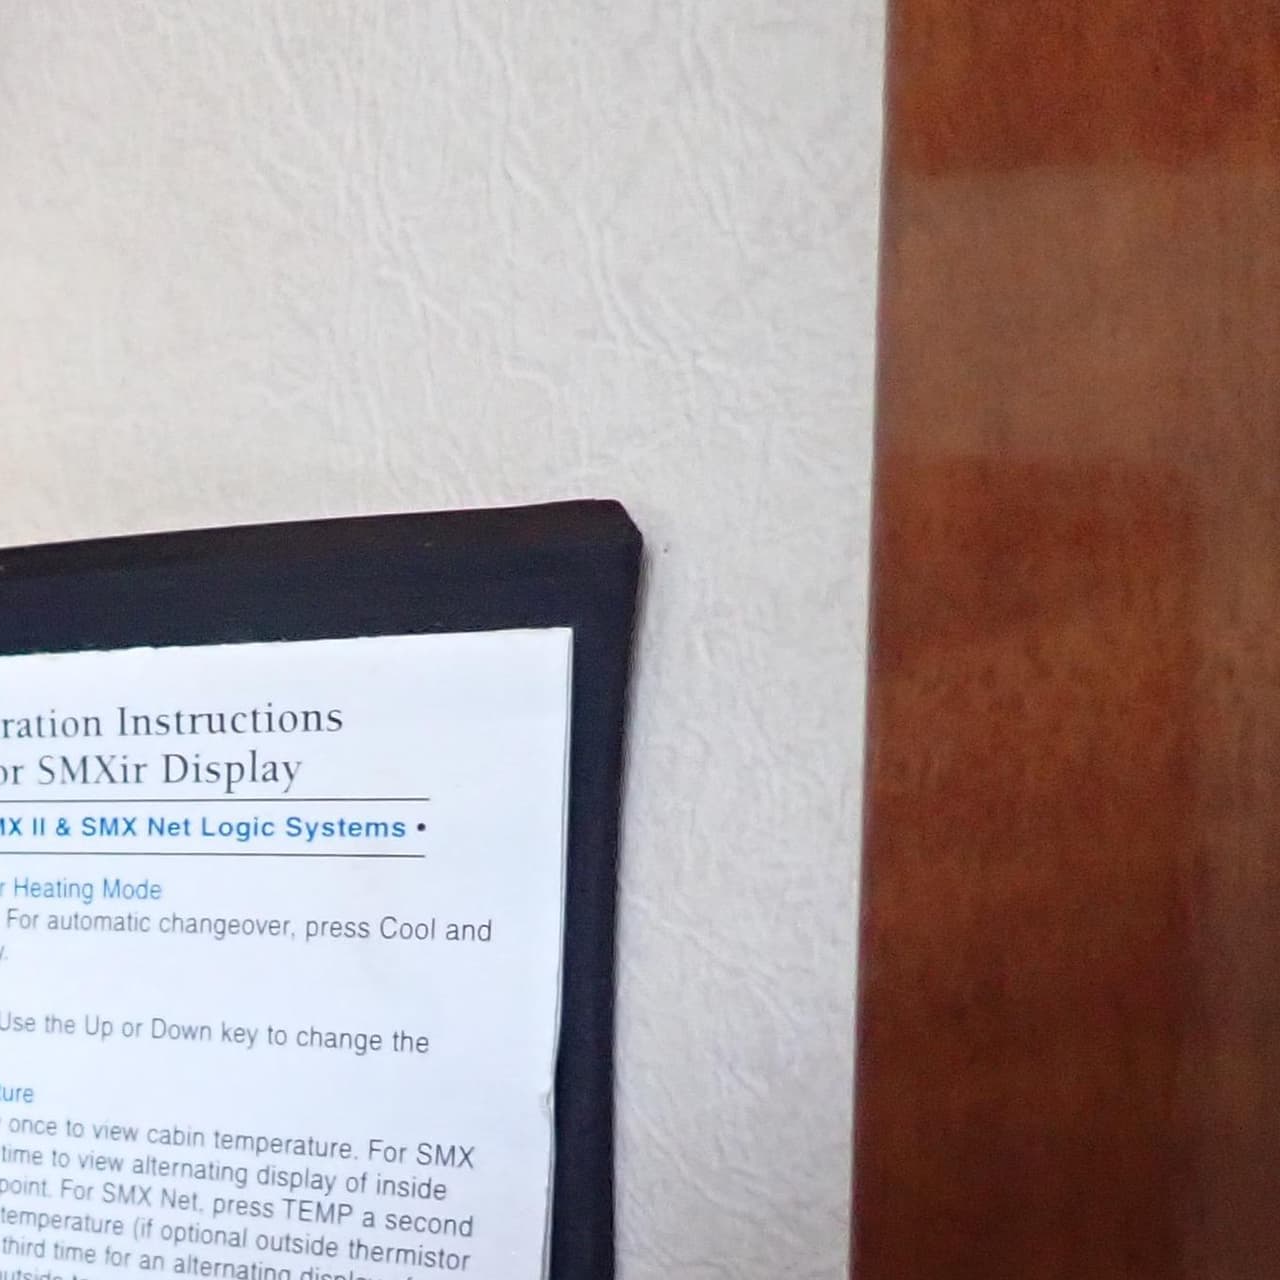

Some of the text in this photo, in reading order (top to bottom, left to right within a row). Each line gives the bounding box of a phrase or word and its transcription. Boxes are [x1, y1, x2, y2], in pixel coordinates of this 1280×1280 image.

[118, 704, 344, 736] Instructions
[38, 755, 149, 785] SMXir
[162, 753, 302, 794] Display
[31, 817, 46, 836] II
[54, 817, 72, 837] &
[81, 817, 138, 837] SMX
[147, 817, 192, 837] Net
[200, 817, 276, 842] Logic
[285, 816, 407, 843] Systems
[12, 877, 95, 905] Heating
[101, 877, 163, 900] Mode
[6, 908, 40, 929] For
[46, 912, 151, 933] automatic
[158, 913, 296, 941] changeover,
[305, 920, 372, 942] press
[378, 916, 437, 940] Cool
[444, 919, 493, 942] and
[44, 1015, 77, 1034] the
[84, 1015, 114, 1041] Up
[121, 1021, 144, 1038] or
[150, 1017, 213, 1040] Down
[220, 1021, 260, 1050] key
[266, 1025, 289, 1046] to
[295, 1026, 384, 1055] change
[391, 1030, 430, 1054] the
[8, 1118, 58, 1136] once
[64, 1119, 85, 1138] to
[92, 1125, 140, 1142] view
[146, 1126, 206, 1147] cabin
[213, 1130, 359, 1160] temperature.
[367, 1139, 409, 1164] For
[415, 1142, 476, 1169] SMX
[0, 1145, 44, 1166] time
[51, 1149, 72, 1168] to
[77, 1151, 125, 1172] view
[131, 1155, 249, 1189] alternating
[255, 1164, 338, 1197] display
[344, 1171, 369, 1194] of
[375, 1172, 448, 1201] inside
[60, 1178, 95, 1200] For
[101, 1182, 153, 1207] SMX
[212, 1197, 275, 1219] press
[280, 1198, 355, 1225] TEMP
[361, 1211, 377, 1228] a
[384, 1213, 475, 1238] second
[0, 1206, 125, 1236] temperature
[132, 1217, 154, 1241] (if
[159, 1223, 249, 1248] optional
[254, 1233, 340, 1258] outside
[347, 1238, 472, 1271] thermistor
[1, 1236, 47, 1258] third
[52, 1242, 97, 1264] time
[104, 1246, 133, 1267] for
[138, 1254, 166, 1271] an
